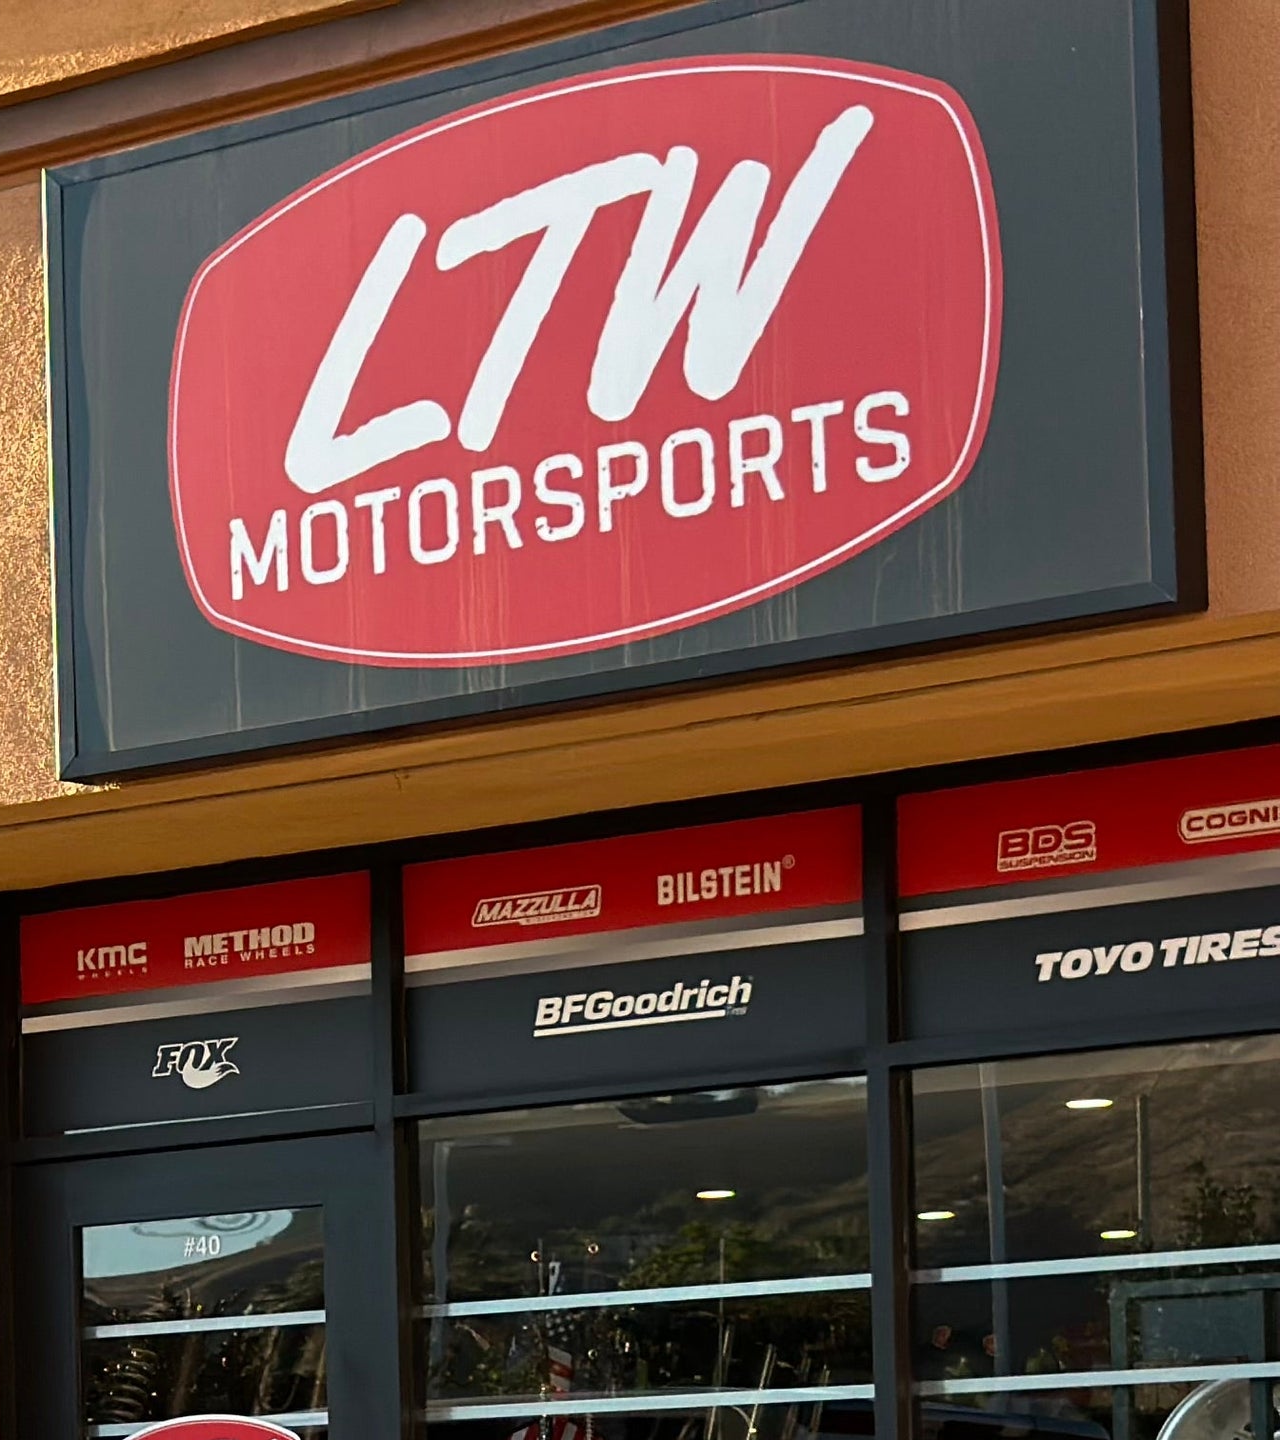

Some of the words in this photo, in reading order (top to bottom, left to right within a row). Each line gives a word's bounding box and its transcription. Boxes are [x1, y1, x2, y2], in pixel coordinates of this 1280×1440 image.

[284, 105, 874, 493] LTW
[229, 390, 910, 601] MOTORSPORTS
[999, 822, 1096, 858] BDS
[999, 849, 1095, 870] SUSPENSION
[657, 861, 781, 905] BILSTEIN
[476, 890, 597, 922] MAZZULLA
[77, 942, 147, 971] KMC
[184, 922, 315, 960] METHOD
[184, 954, 228, 969] RACE
[240, 944, 315, 961] WHEELS
[1035, 941, 1154, 982] TOYO
[1160, 925, 1280, 967] TIRES
[535, 975, 752, 1027] BFGoodrich
[152, 1037, 239, 1079] FOX
[183, 1235, 221, 1257] #40
